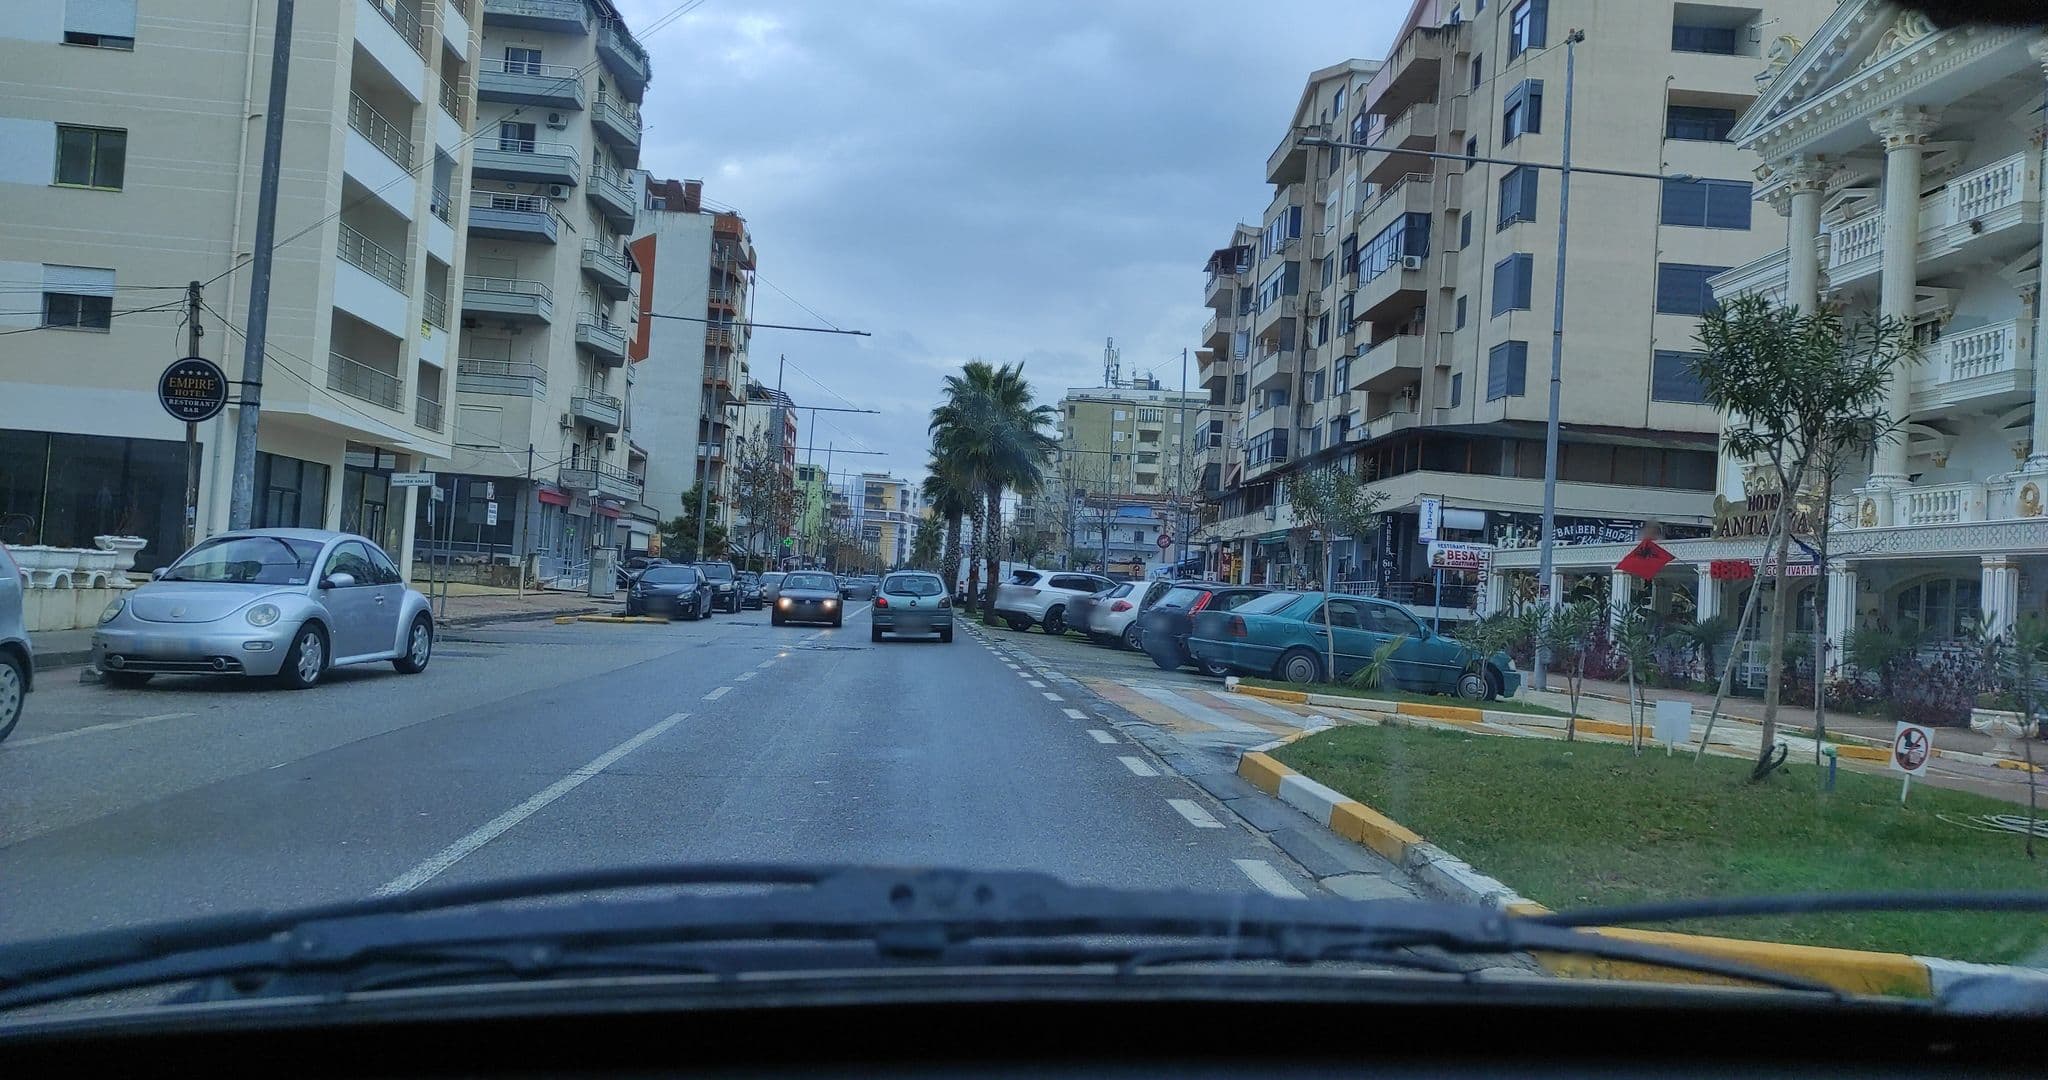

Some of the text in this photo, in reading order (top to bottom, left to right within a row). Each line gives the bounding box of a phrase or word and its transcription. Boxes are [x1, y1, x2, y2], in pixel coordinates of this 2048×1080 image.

[170, 377, 215, 390] EMPIRE
[175, 389, 208, 397] HOTEL
[168, 399, 216, 407] RESTORANT
[1556, 525, 1597, 538] BARBER
[1447, 550, 1477, 561] BESA
